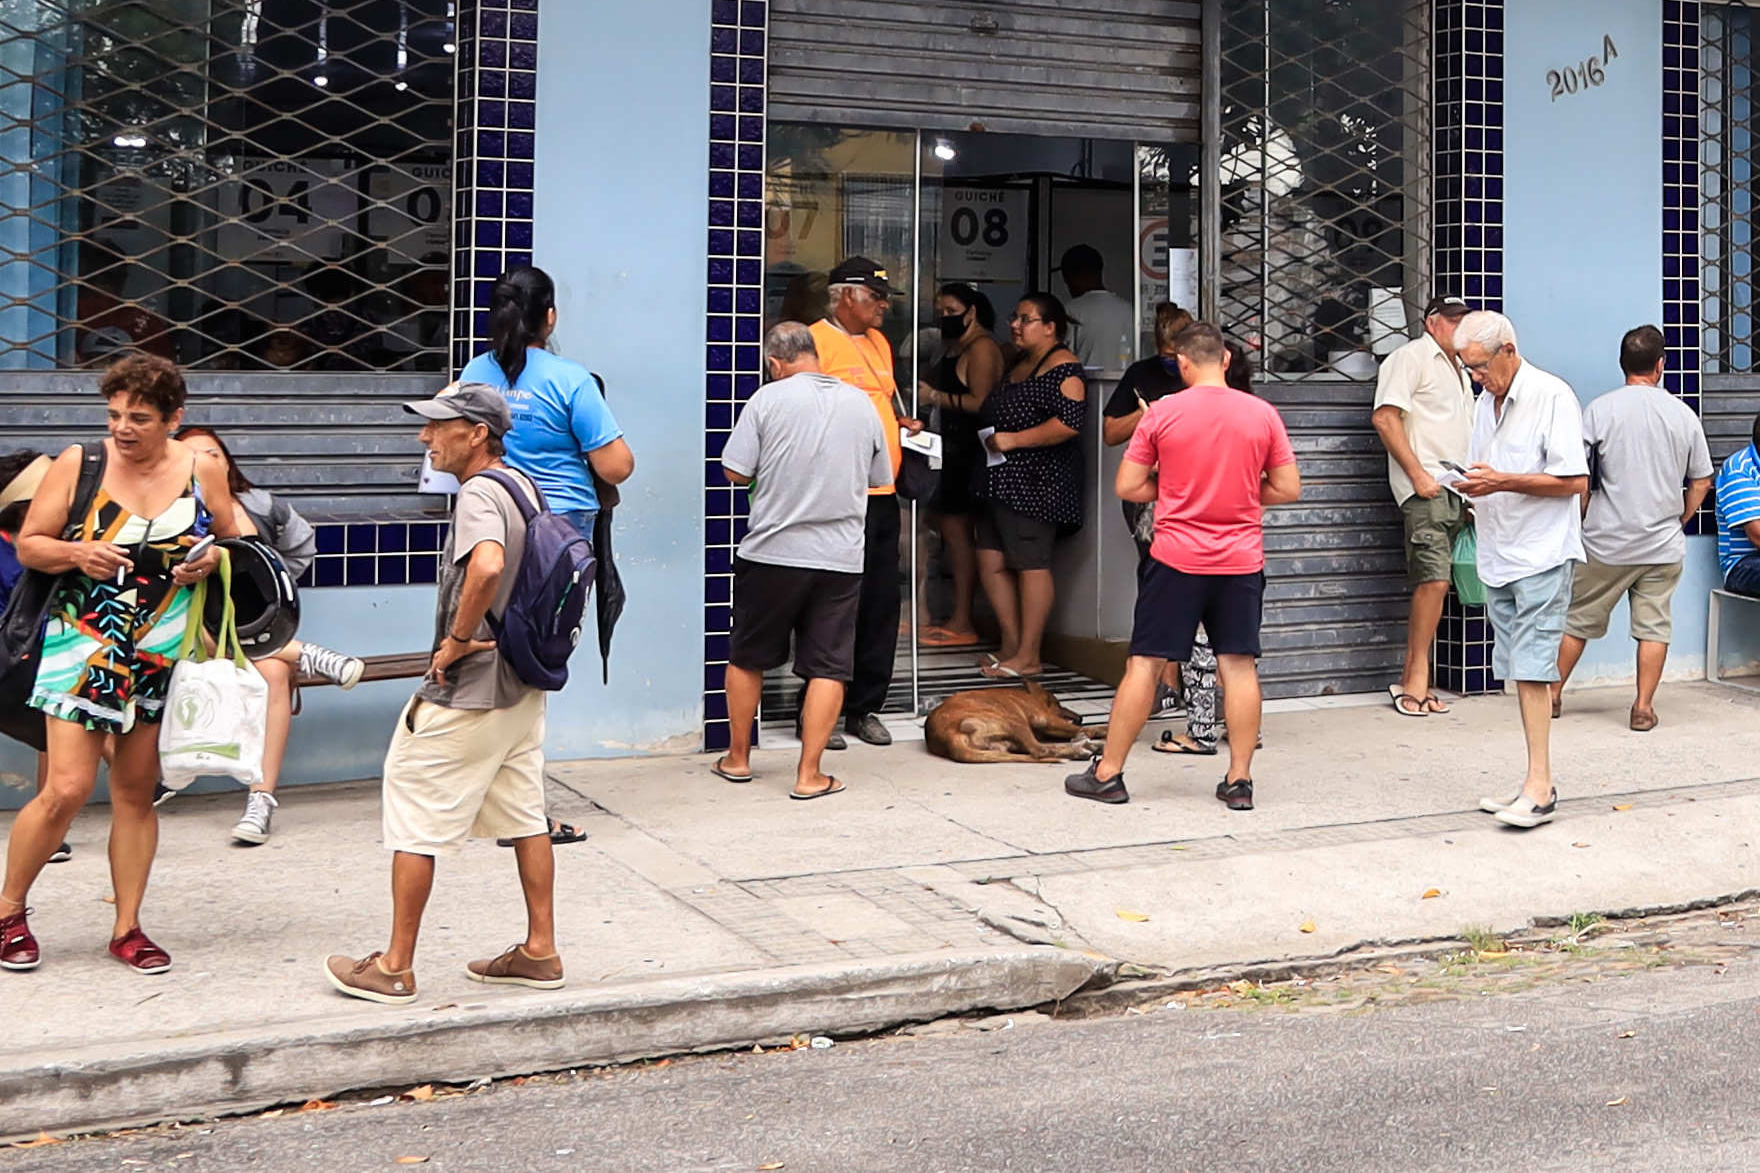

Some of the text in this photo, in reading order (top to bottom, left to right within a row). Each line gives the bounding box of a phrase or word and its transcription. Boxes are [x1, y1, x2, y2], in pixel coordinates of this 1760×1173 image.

[241, 178, 313, 224] 04
[954, 190, 1005, 203] GUICHÊ
[950, 206, 1009, 247] 08
